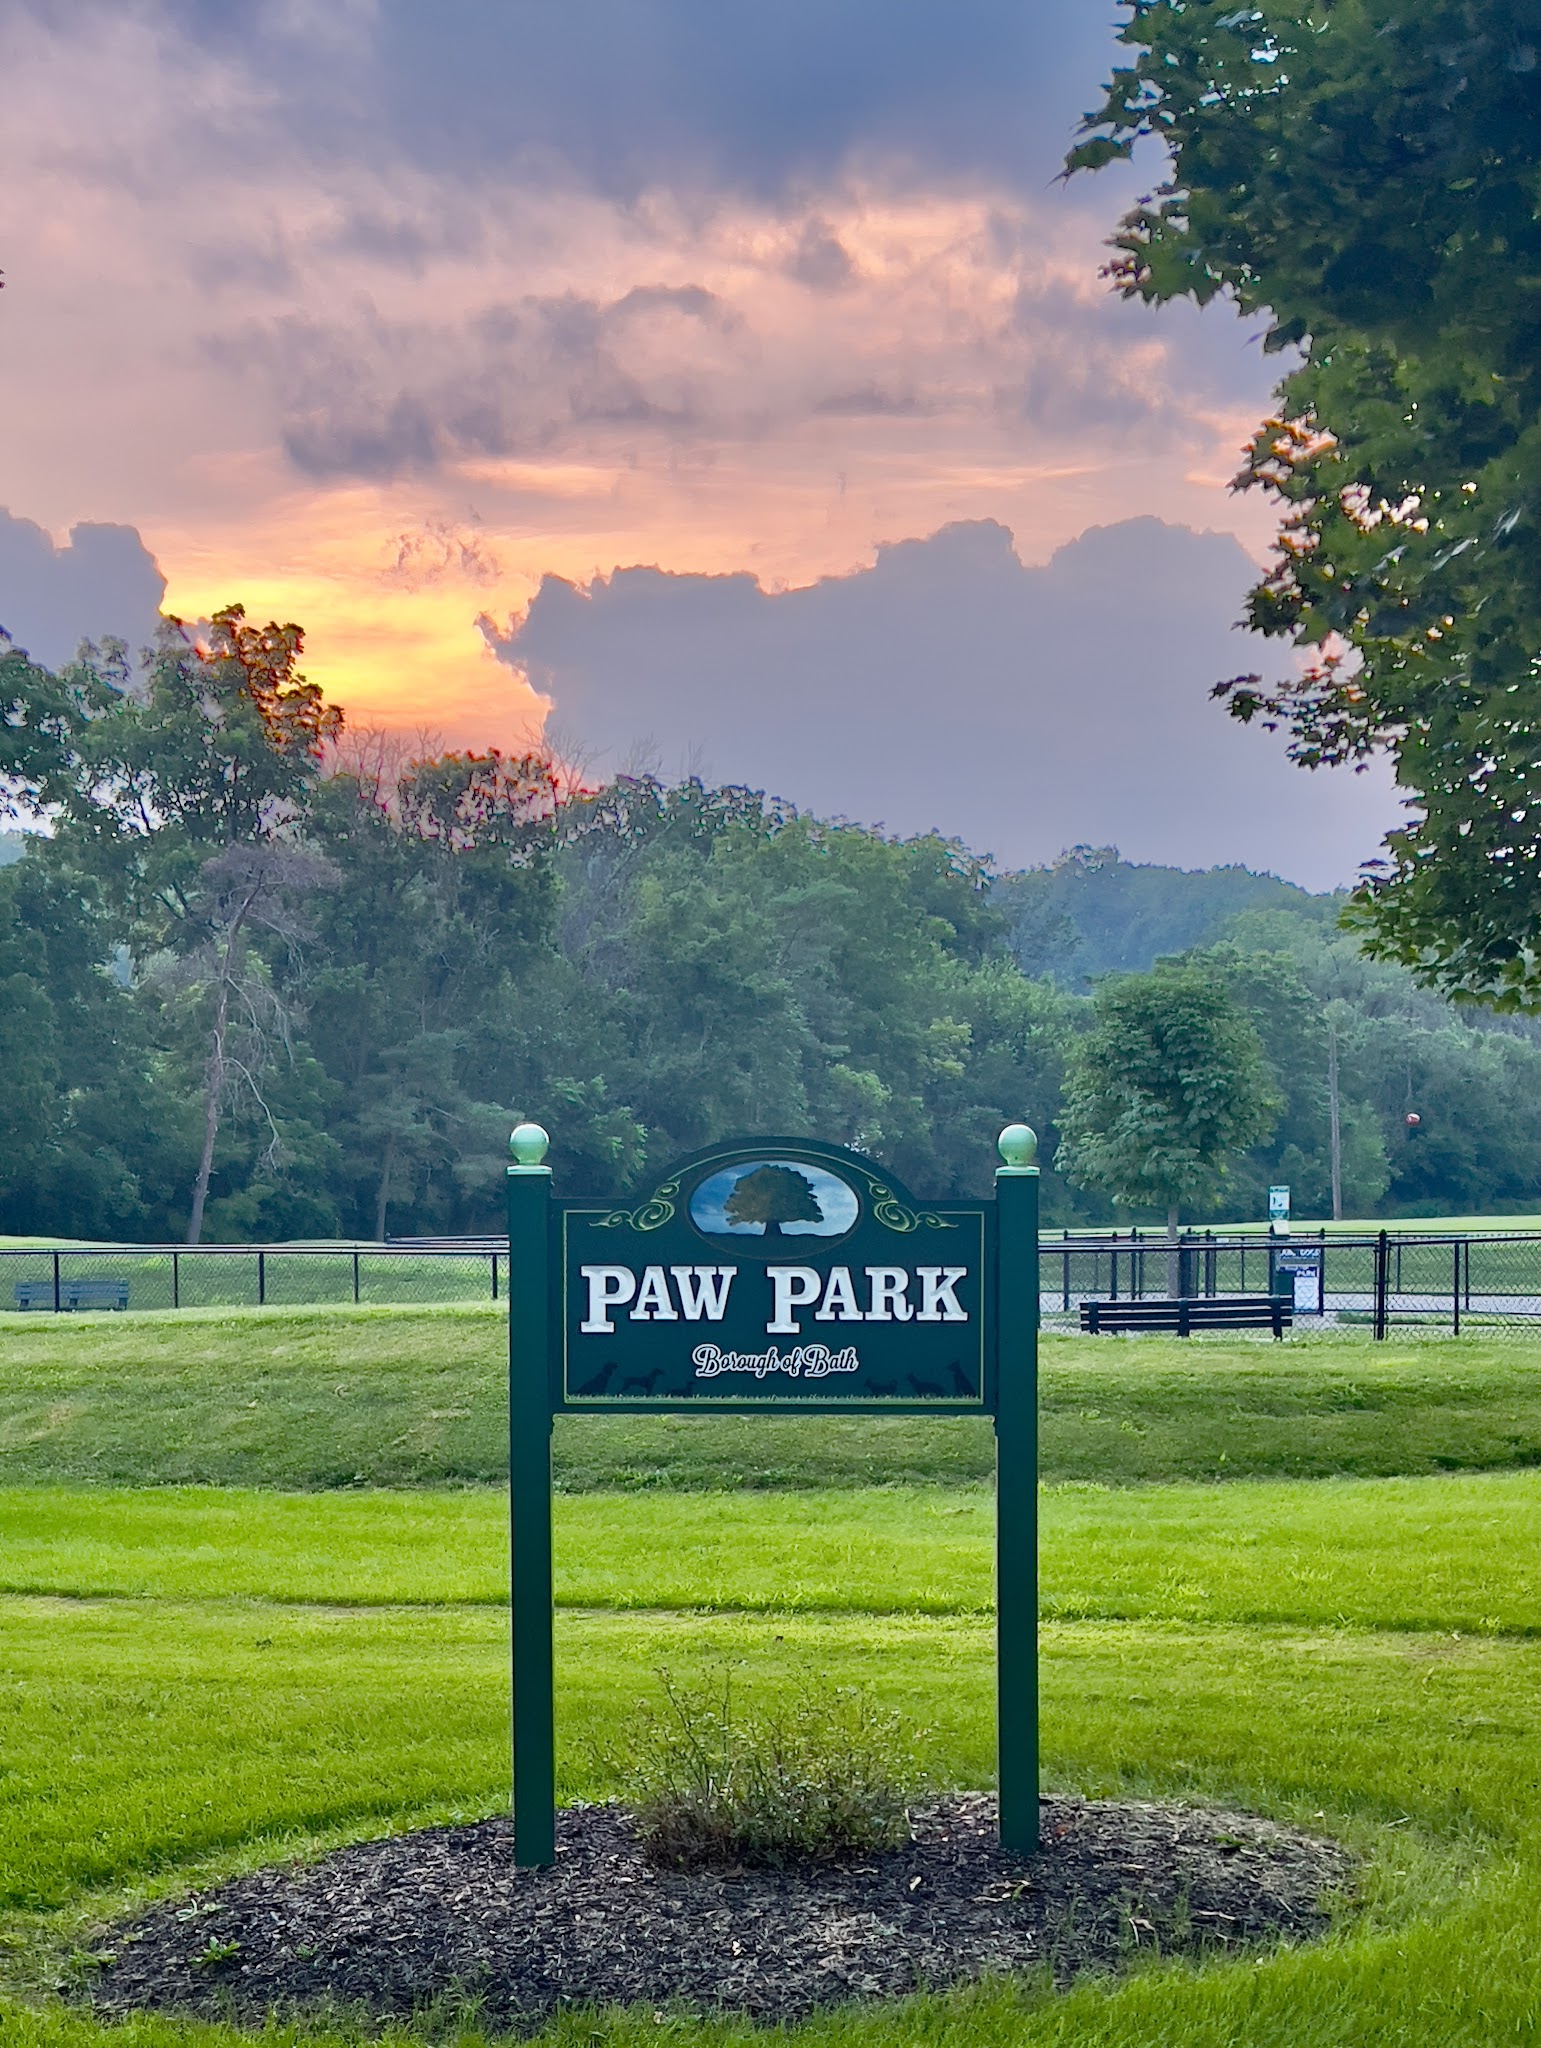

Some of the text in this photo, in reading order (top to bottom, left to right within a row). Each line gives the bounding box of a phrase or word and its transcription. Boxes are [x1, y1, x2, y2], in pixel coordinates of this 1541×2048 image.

[580, 1265, 969, 1334] PAW PARK
[692, 1343, 859, 1379] Borough of Bath
